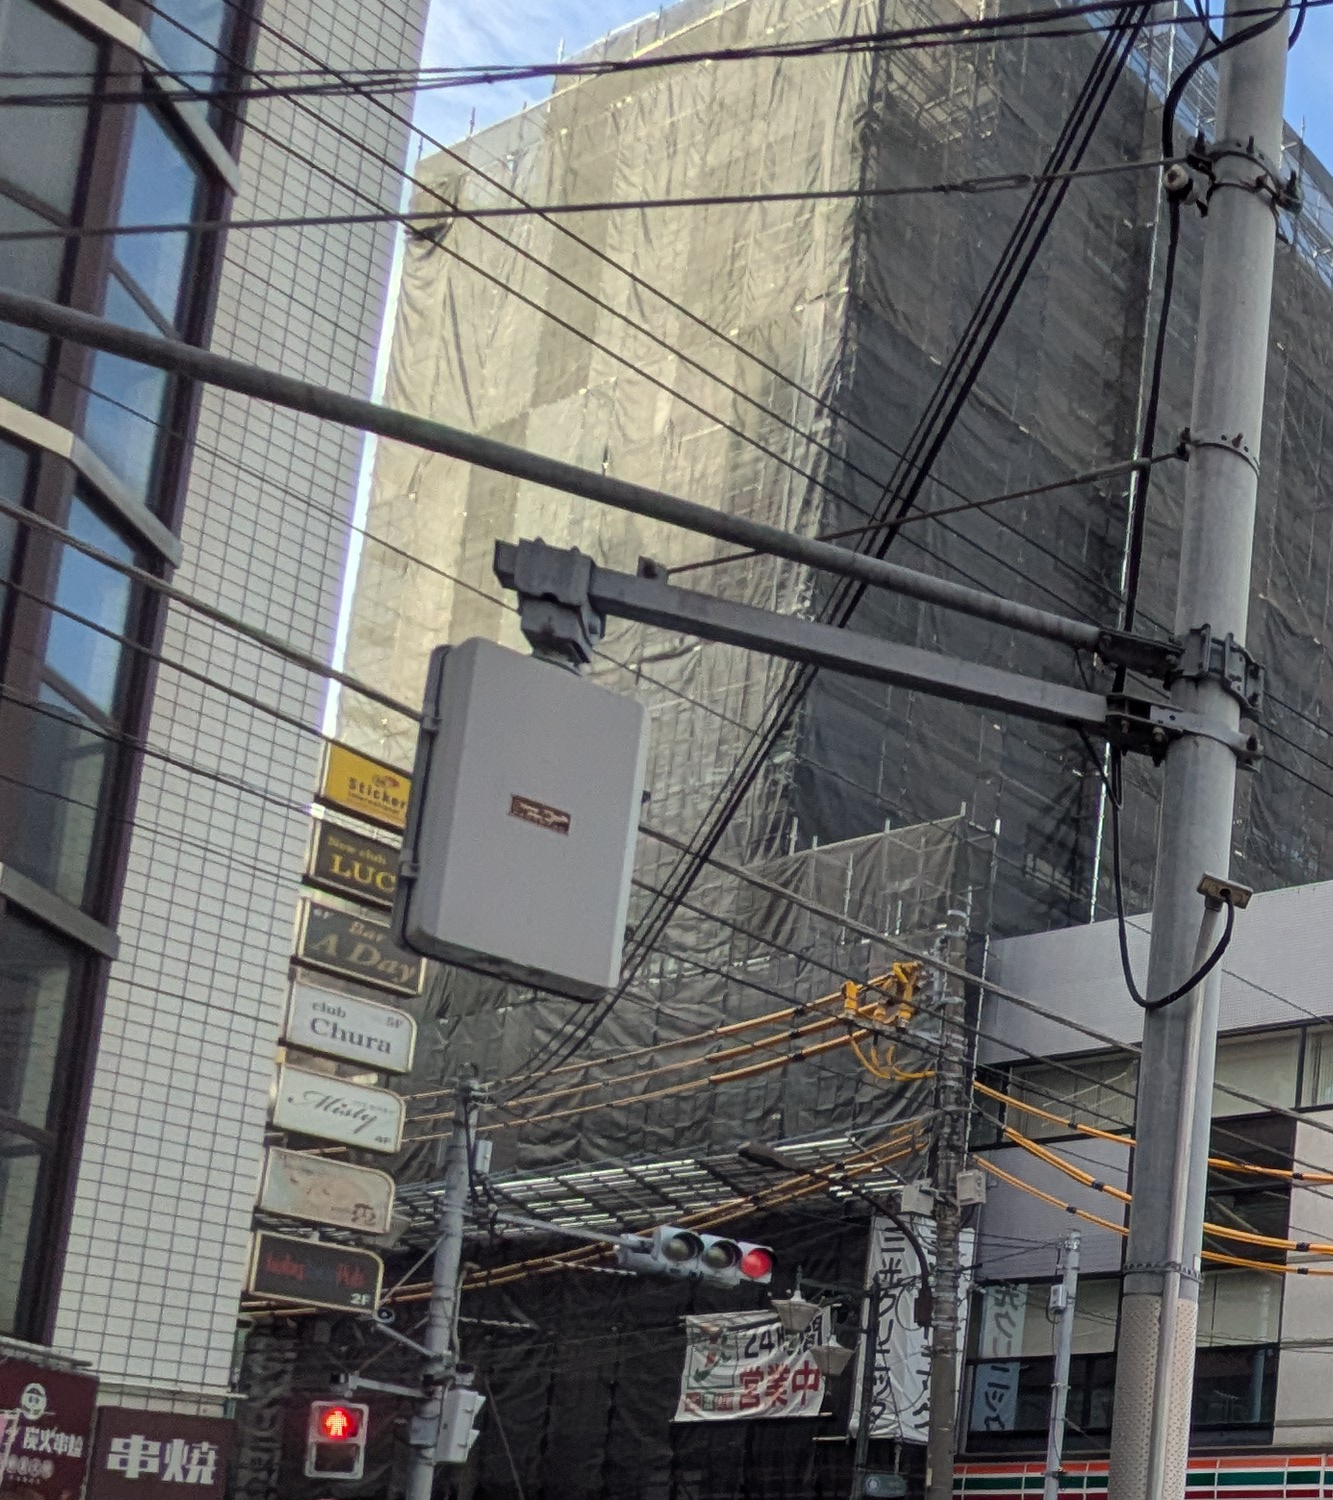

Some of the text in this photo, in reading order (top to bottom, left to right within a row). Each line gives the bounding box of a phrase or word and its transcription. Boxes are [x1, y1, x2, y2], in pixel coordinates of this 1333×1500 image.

[311, 999, 348, 1019] club
[310, 1016, 393, 1056] Chura
[287, 1089, 379, 1135] Misty
[349, 1291, 372, 1307] 2F
[739, 1359, 821, 1410] 営業中
[106, 1433, 219, 1485] 串焼
